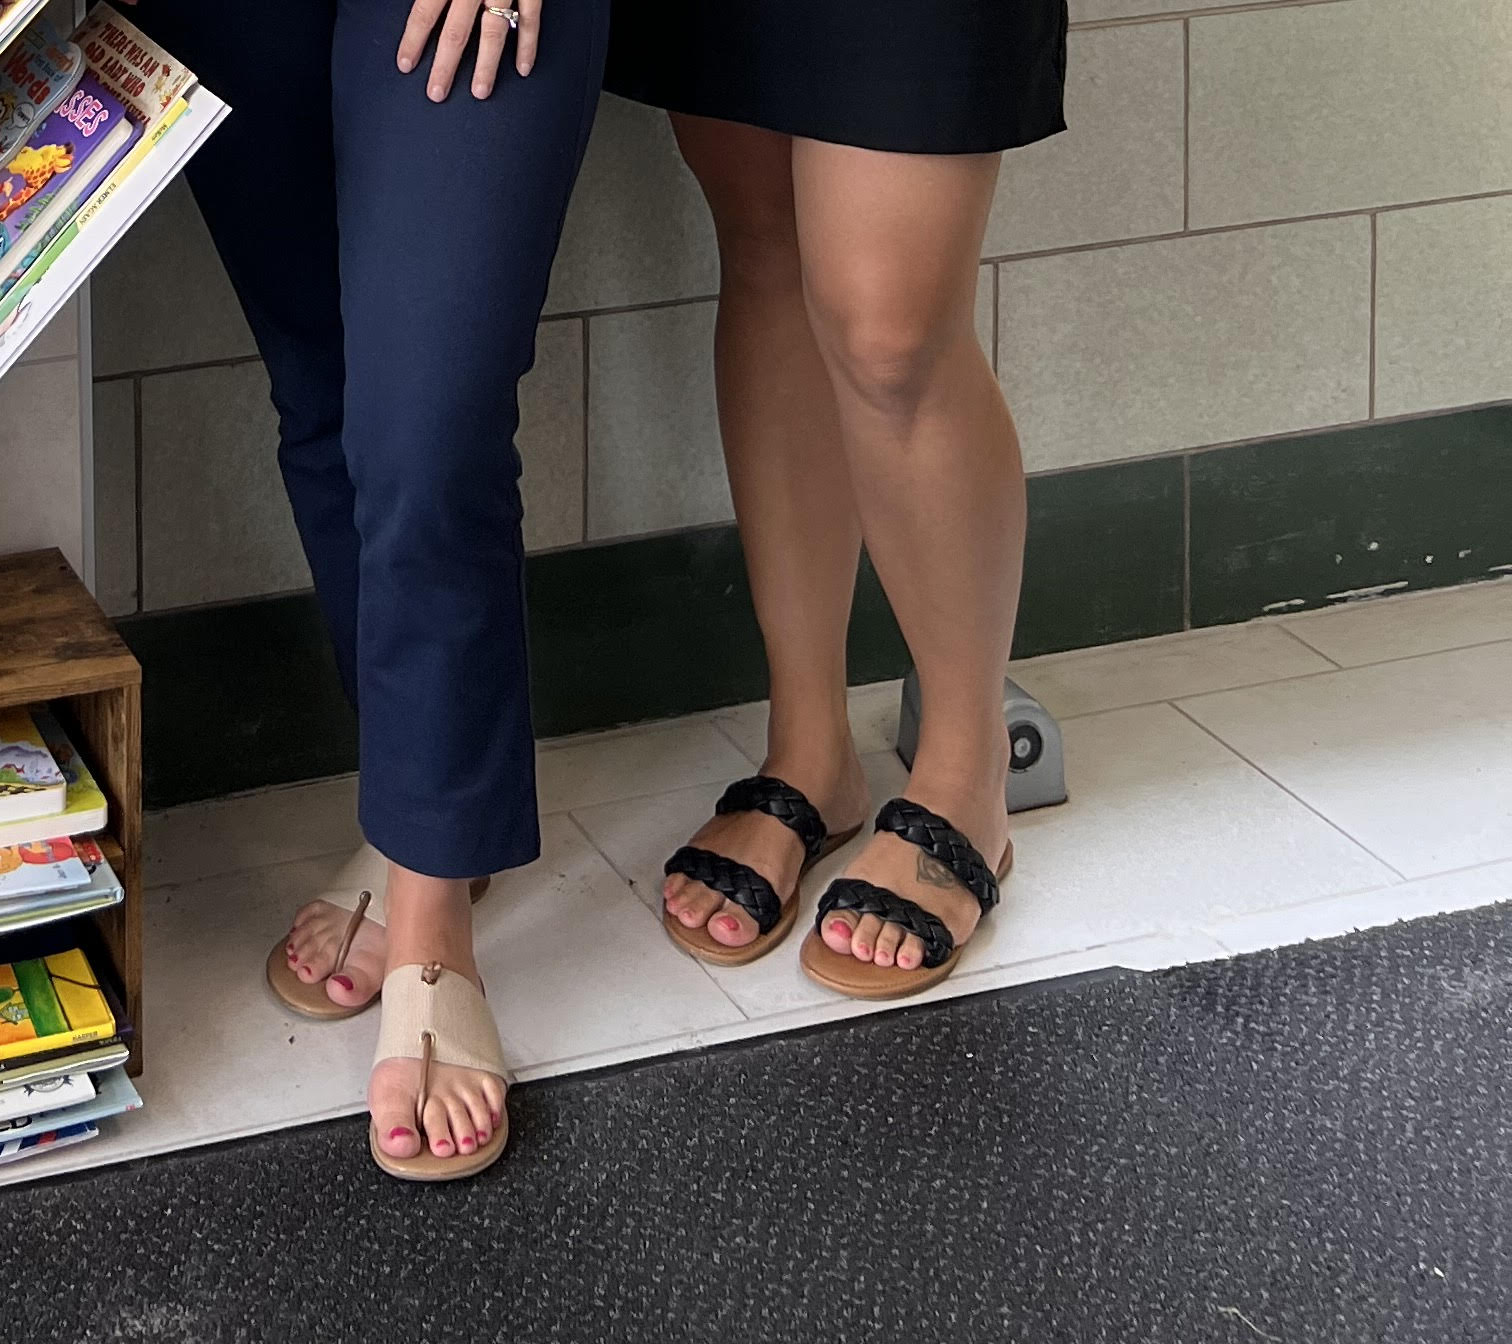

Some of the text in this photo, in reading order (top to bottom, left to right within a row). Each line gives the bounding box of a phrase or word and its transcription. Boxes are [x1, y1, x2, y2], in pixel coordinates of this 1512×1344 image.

[1, 49, 51, 105] Words
[81, 39, 107, 65] OLD
[99, 54, 129, 83] LADY
[119, 70, 148, 99] WHO
[98, 22, 160, 79] THERE WAS AN
[77, 180, 117, 227] ELMER AGAIN
